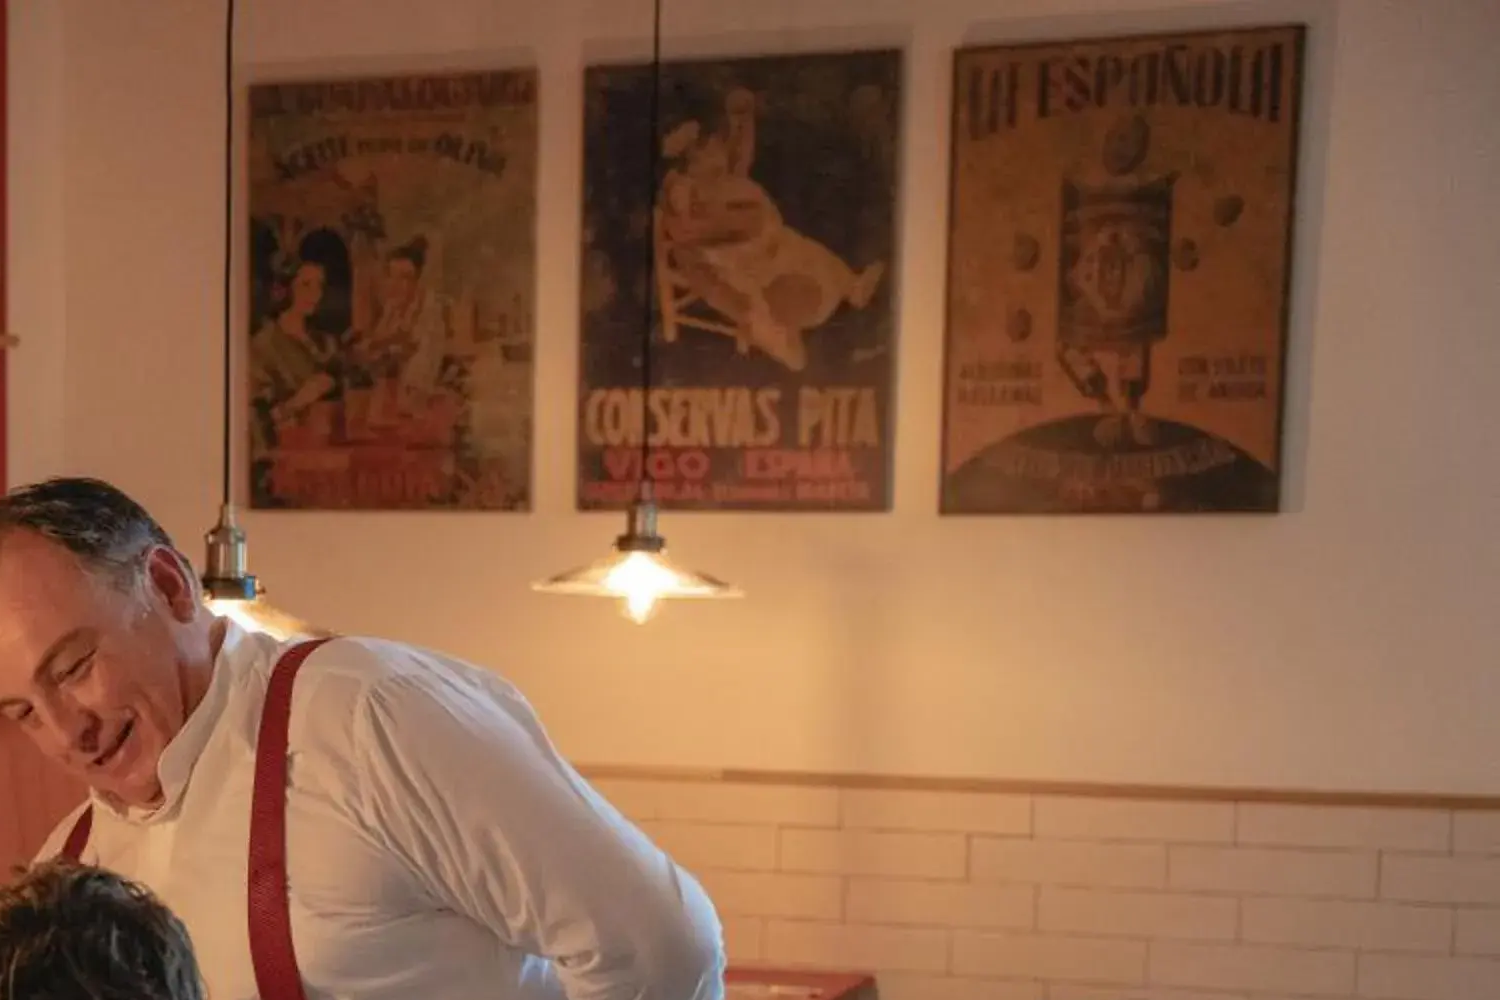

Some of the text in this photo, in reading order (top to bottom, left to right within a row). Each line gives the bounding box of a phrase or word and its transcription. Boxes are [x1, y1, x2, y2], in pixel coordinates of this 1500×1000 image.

[966, 62, 1022, 141] LA
[797, 386, 879, 448] PITA
[603, 449, 711, 481] VIGO
